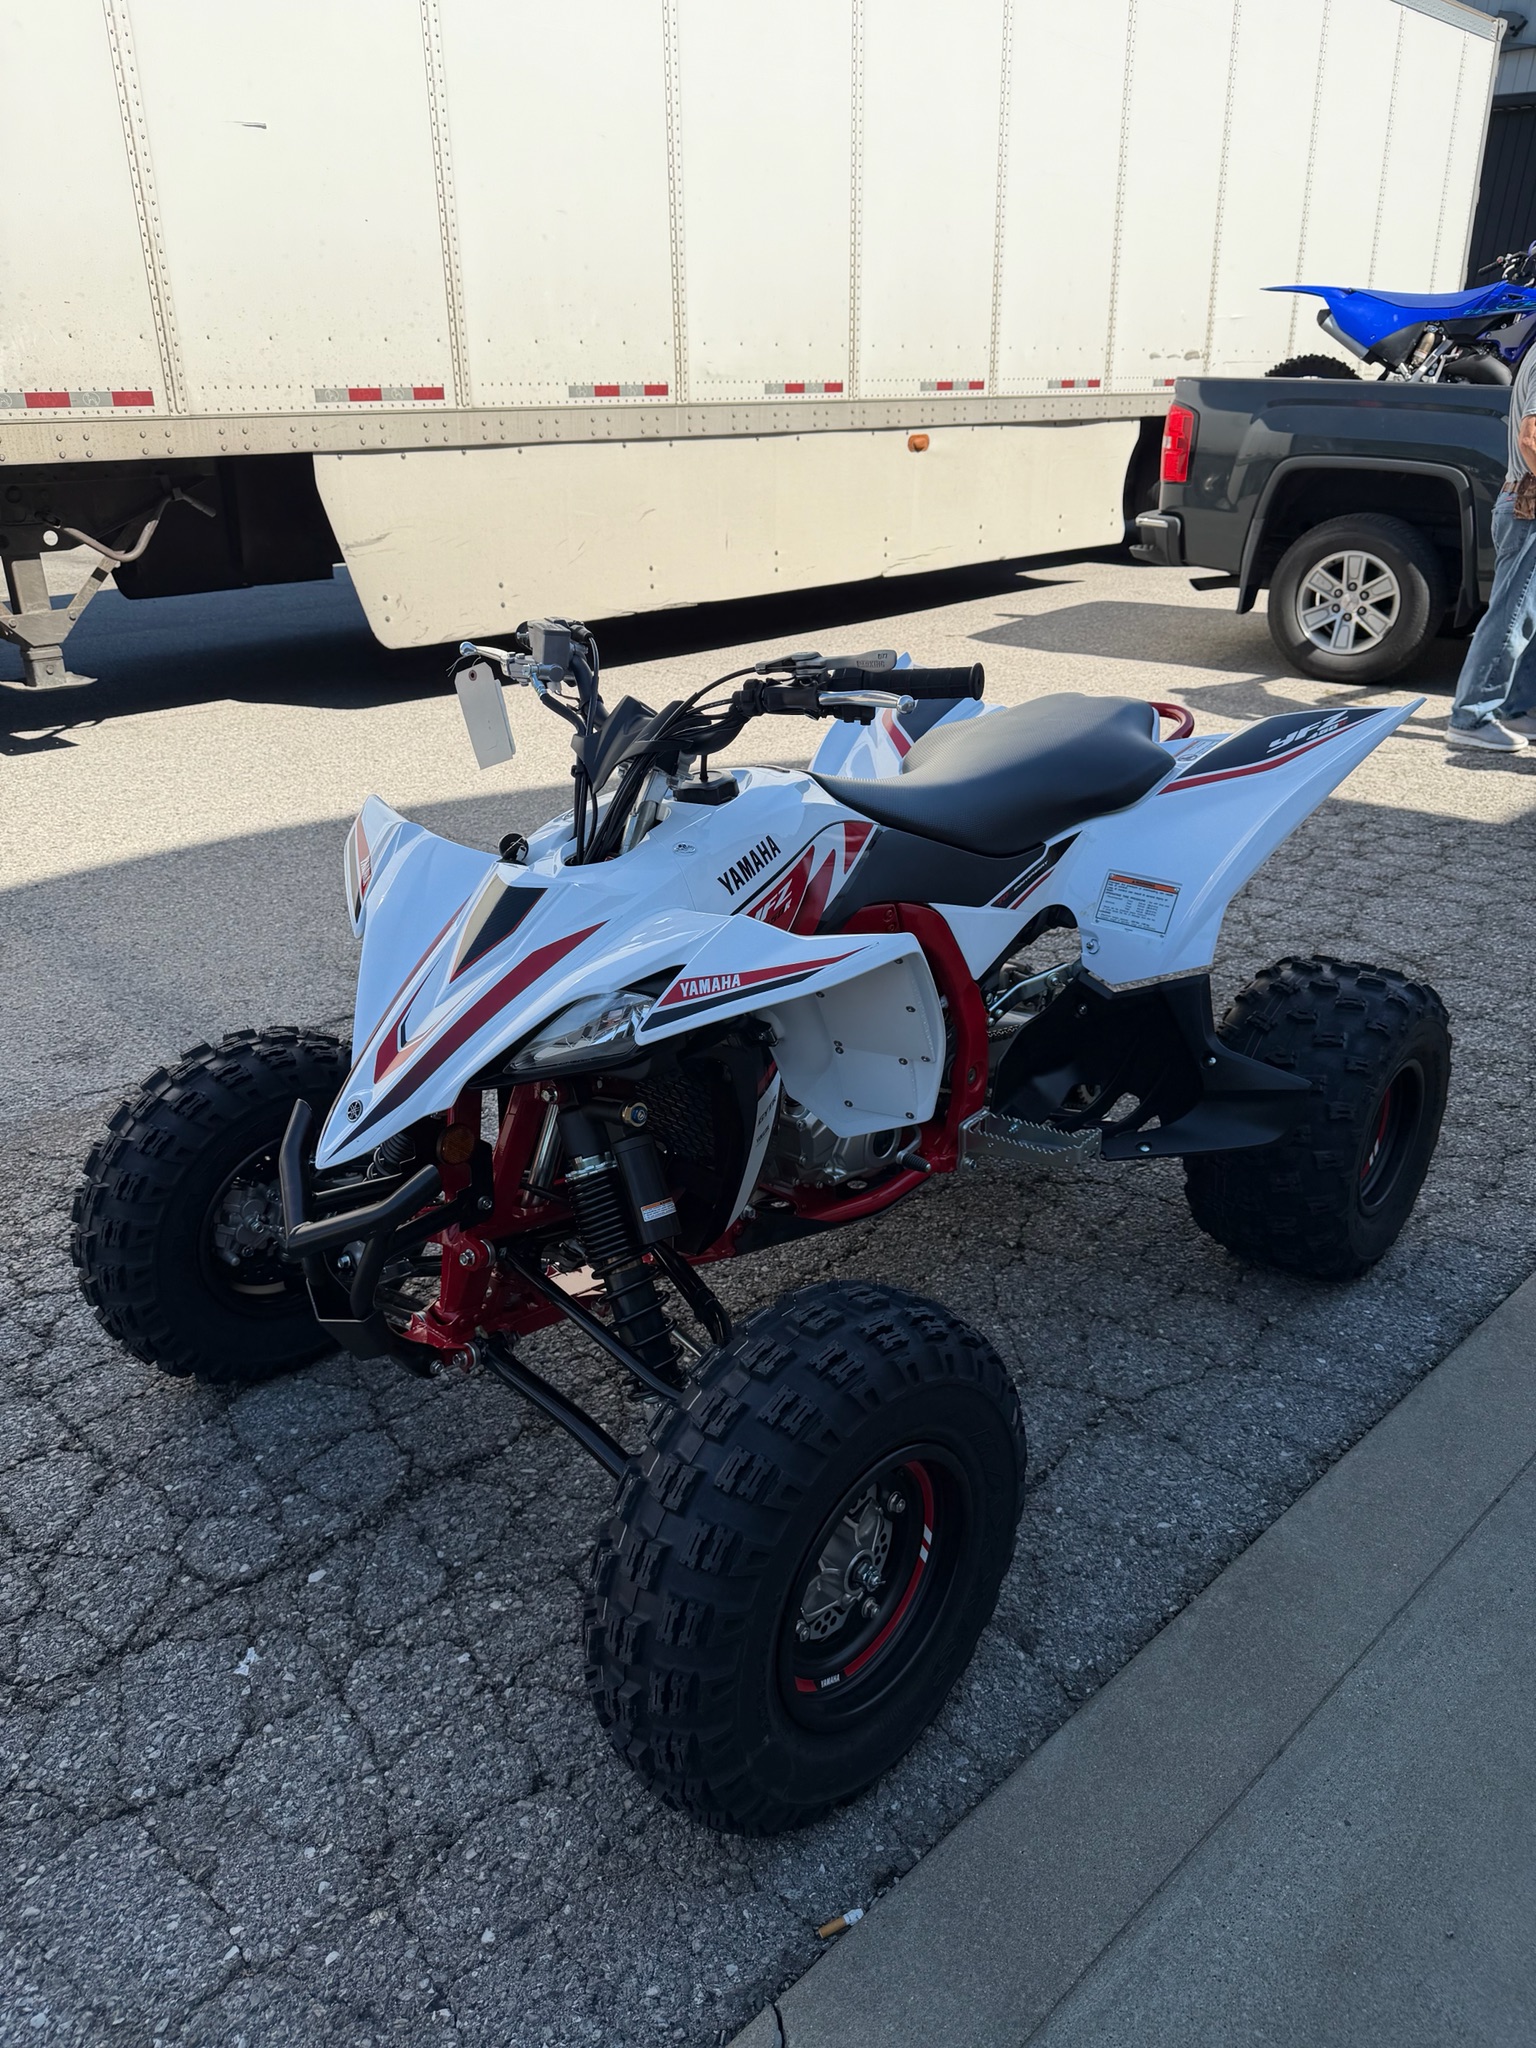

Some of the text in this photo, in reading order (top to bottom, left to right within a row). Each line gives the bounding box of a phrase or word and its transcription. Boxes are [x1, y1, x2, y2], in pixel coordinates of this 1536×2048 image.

[1266, 710, 1349, 753] YFZ
[717, 835, 782, 896] YAMAHA
[680, 974, 741, 998] YAMAHA
